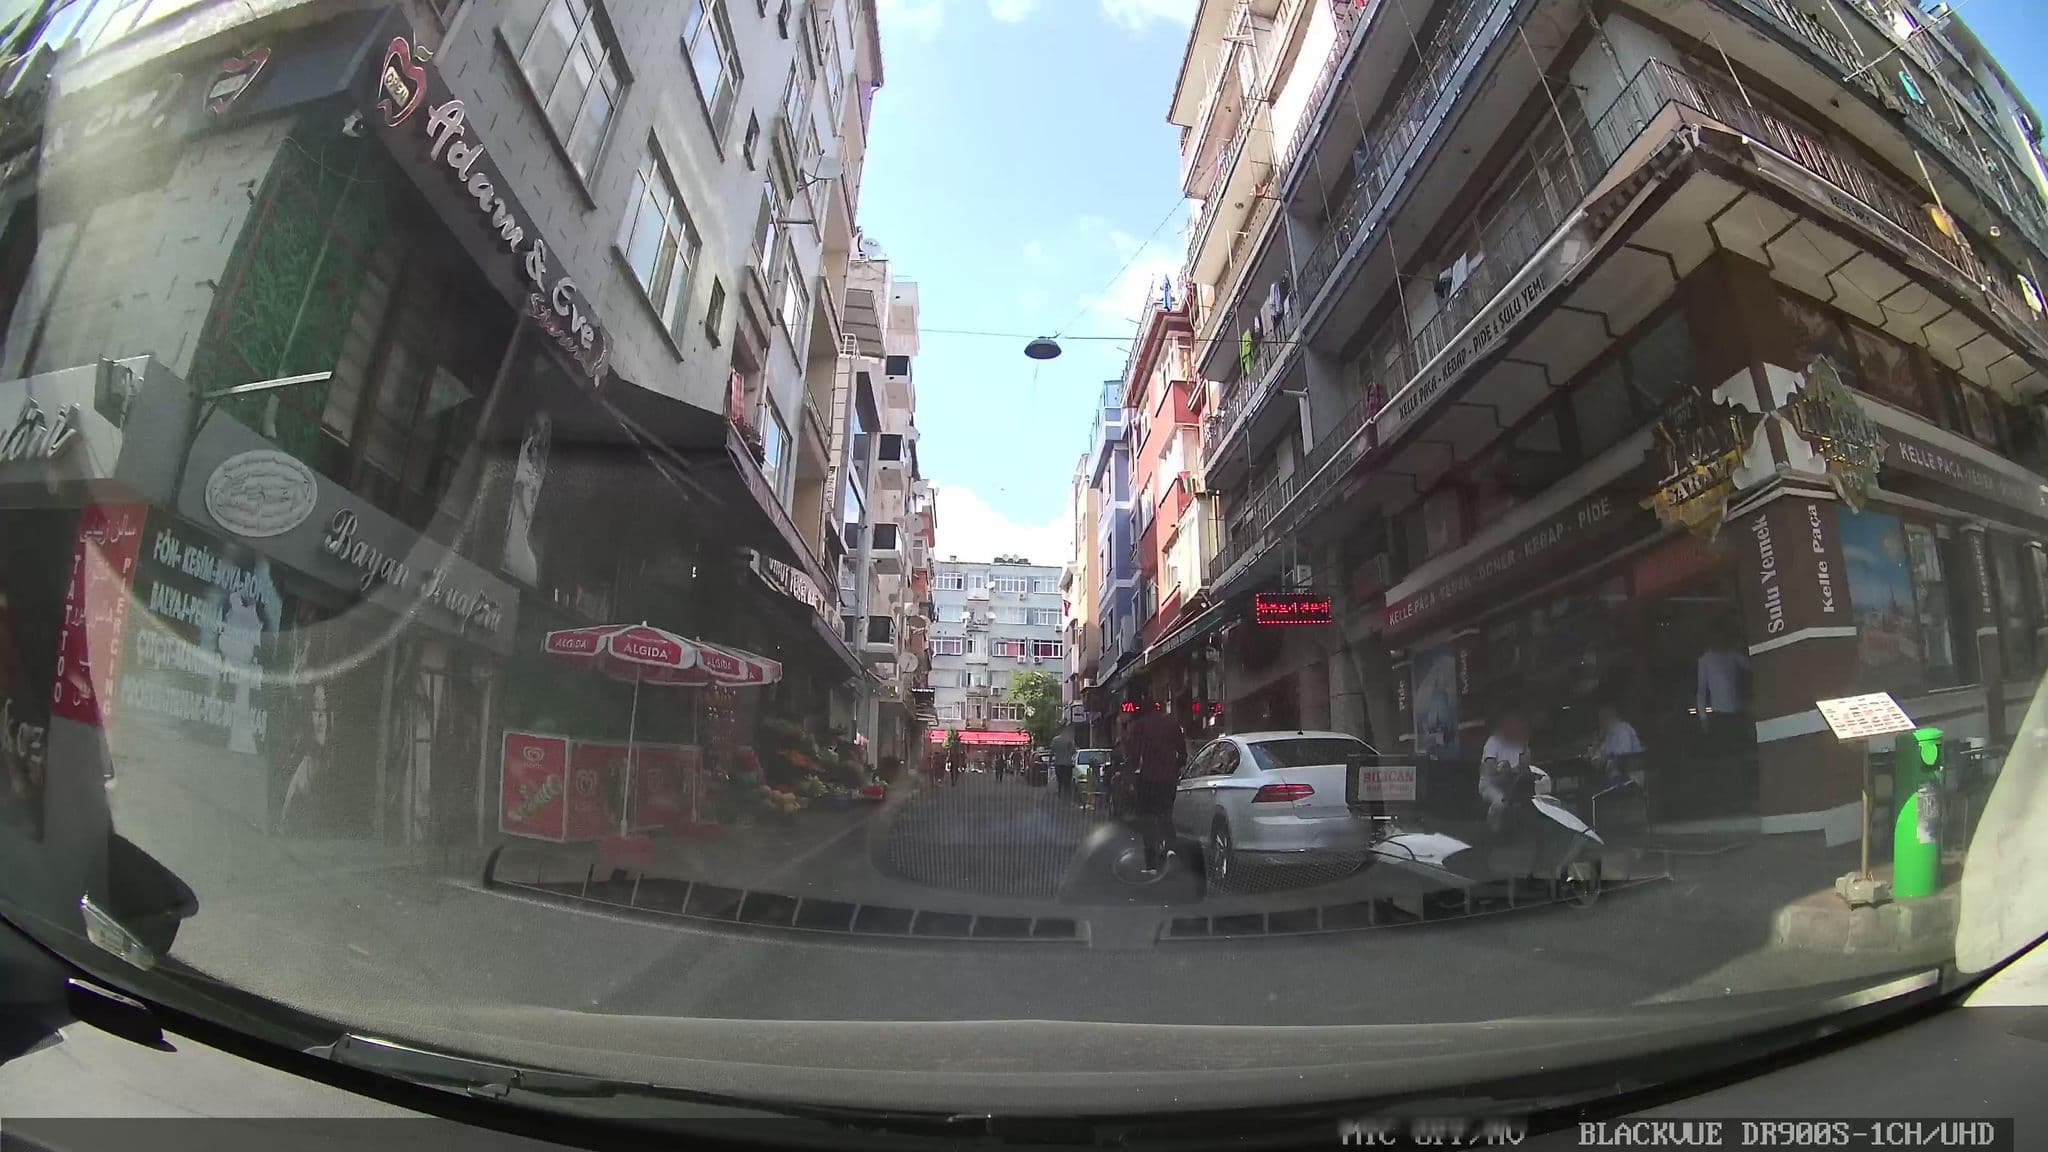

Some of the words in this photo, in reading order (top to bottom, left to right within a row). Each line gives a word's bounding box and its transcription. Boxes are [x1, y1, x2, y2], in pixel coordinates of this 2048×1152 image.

[426, 98, 524, 254] Adam
[552, 276, 595, 351] Eve
[1899, 441, 1938, 471] KELLE
[322, 508, 410, 592] Bayan
[1751, 512, 1778, 585] Yemek
[1807, 503, 1825, 553] Paça
[1763, 584, 1785, 634] Sulu
[1817, 560, 1835, 613] Kelle
[53, 554, 81, 704] TATTOO
[102, 557, 132, 717] PIERCING
[1388, 600, 1415, 627] KELLE
[555, 638, 588, 650] ALGIDA
[623, 642, 669, 661] ALGIDA
